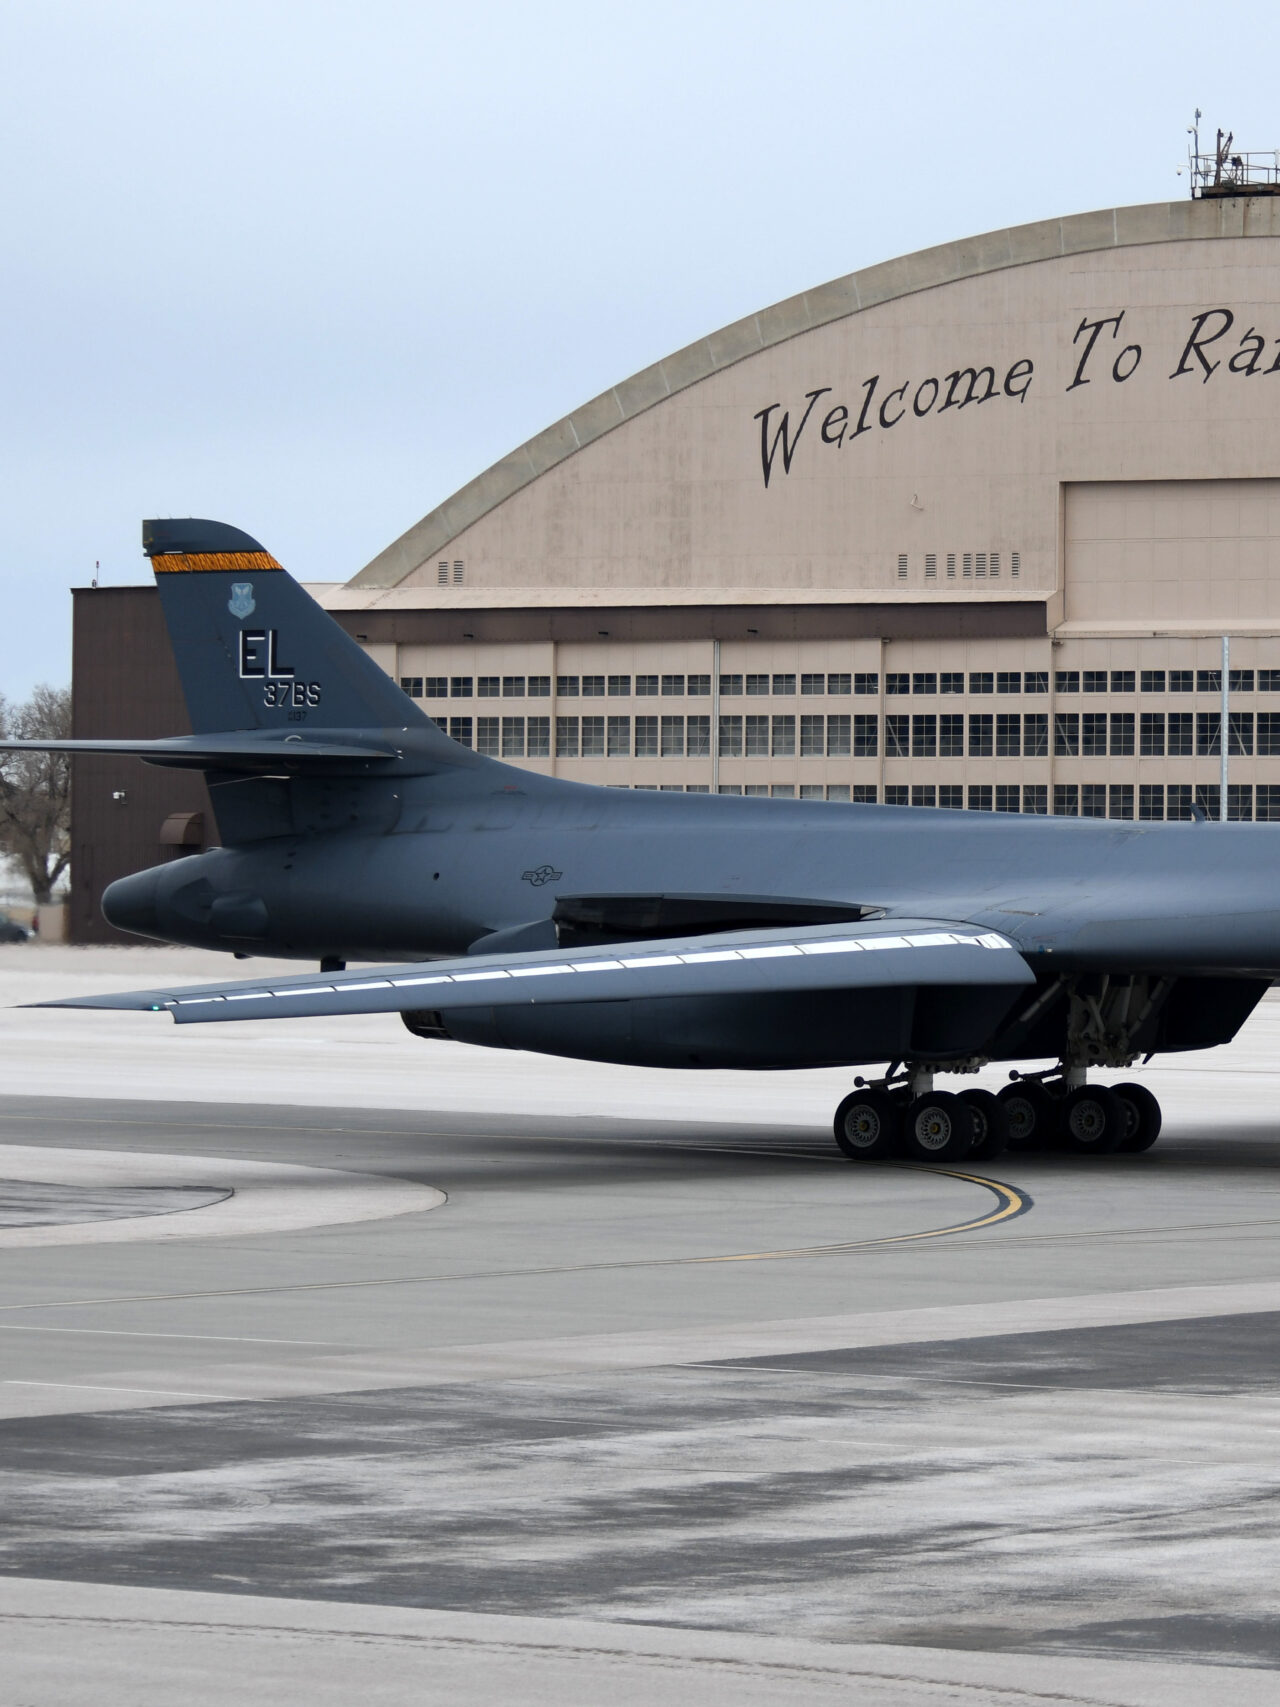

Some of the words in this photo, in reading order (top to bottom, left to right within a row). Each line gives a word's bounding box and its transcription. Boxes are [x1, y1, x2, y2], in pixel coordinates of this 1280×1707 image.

[753, 357, 1034, 489] Welcome
[1065, 309, 1142, 392] To
[239, 629, 296, 679] EL
[263, 681, 321, 708] 37BS
